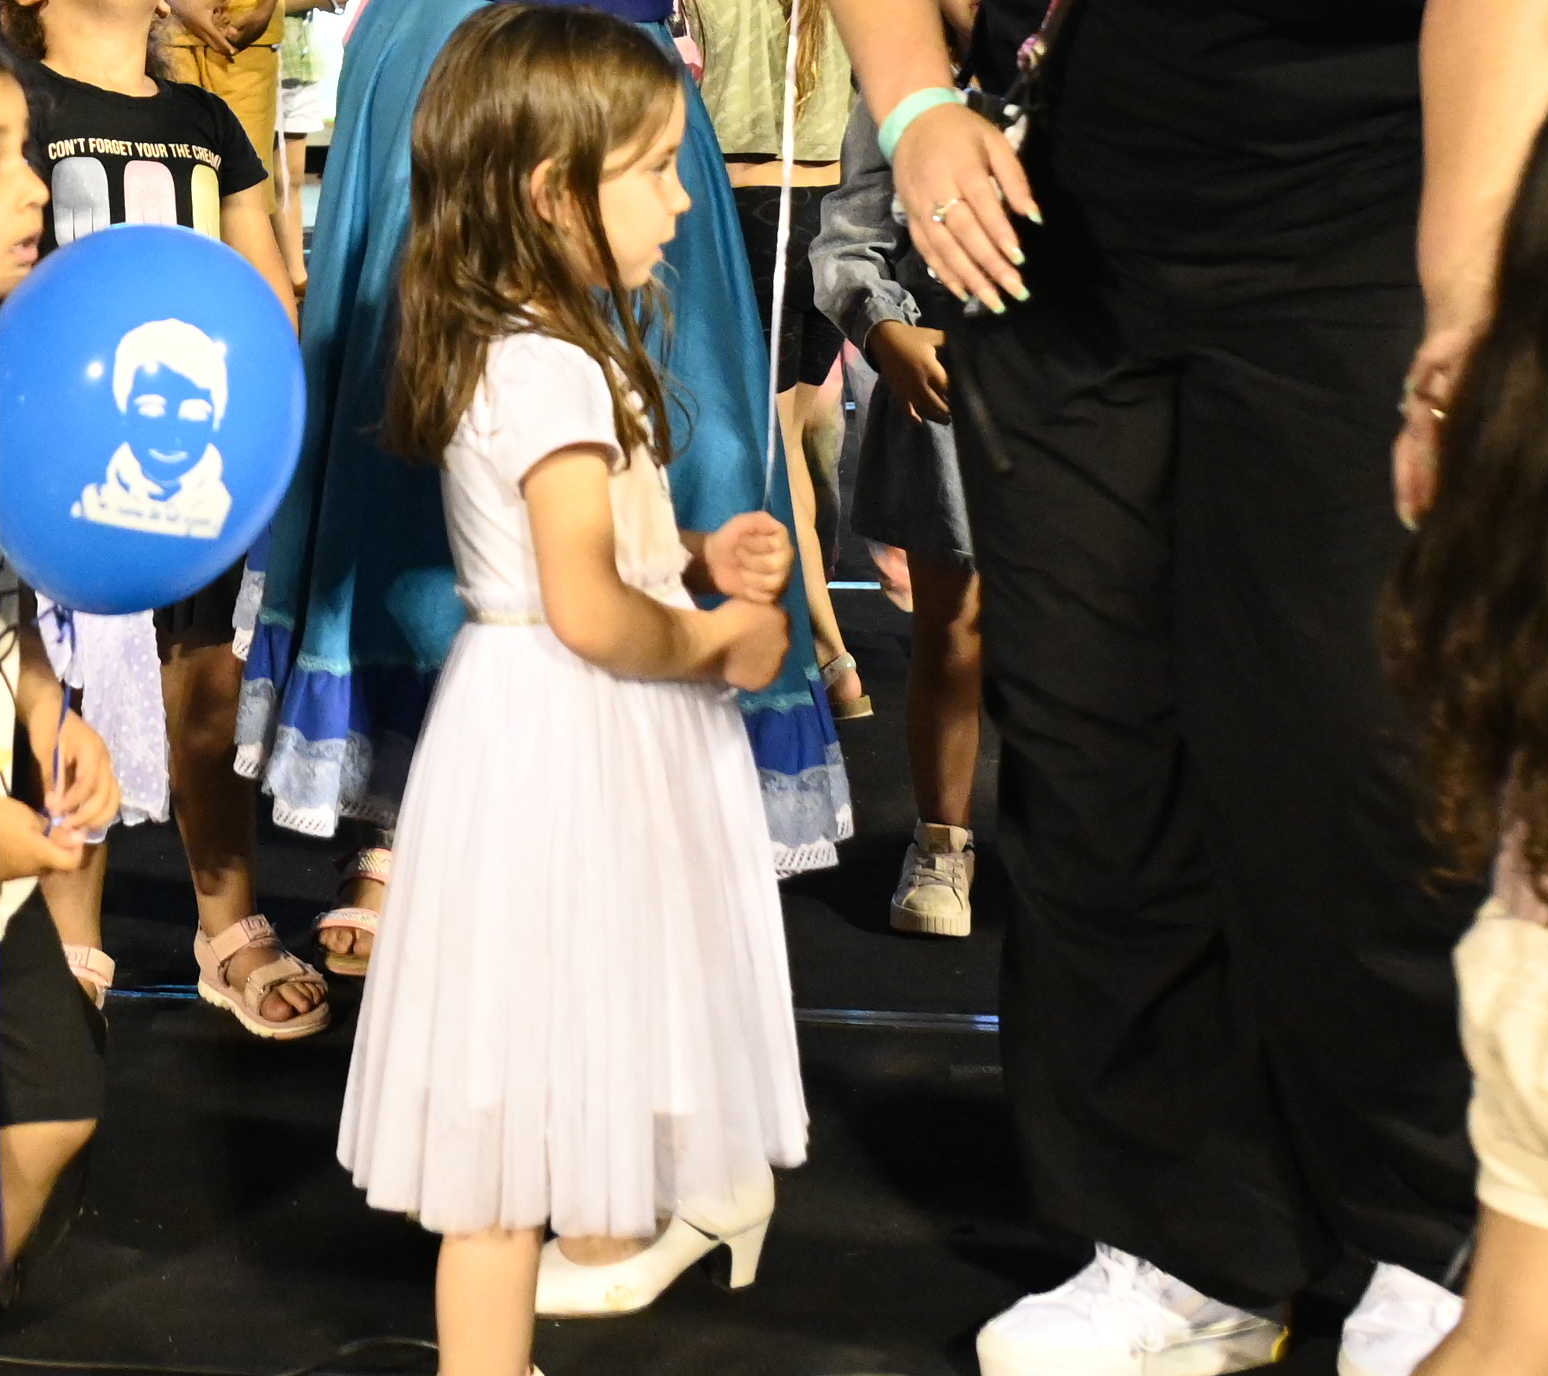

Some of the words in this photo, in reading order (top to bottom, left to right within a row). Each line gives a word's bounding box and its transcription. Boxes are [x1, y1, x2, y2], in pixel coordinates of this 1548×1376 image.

[48, 137, 85, 160] CON'T
[88, 137, 133, 157] FORGET
[134, 141, 168, 158] YOUR
[168, 143, 193, 159] THE
